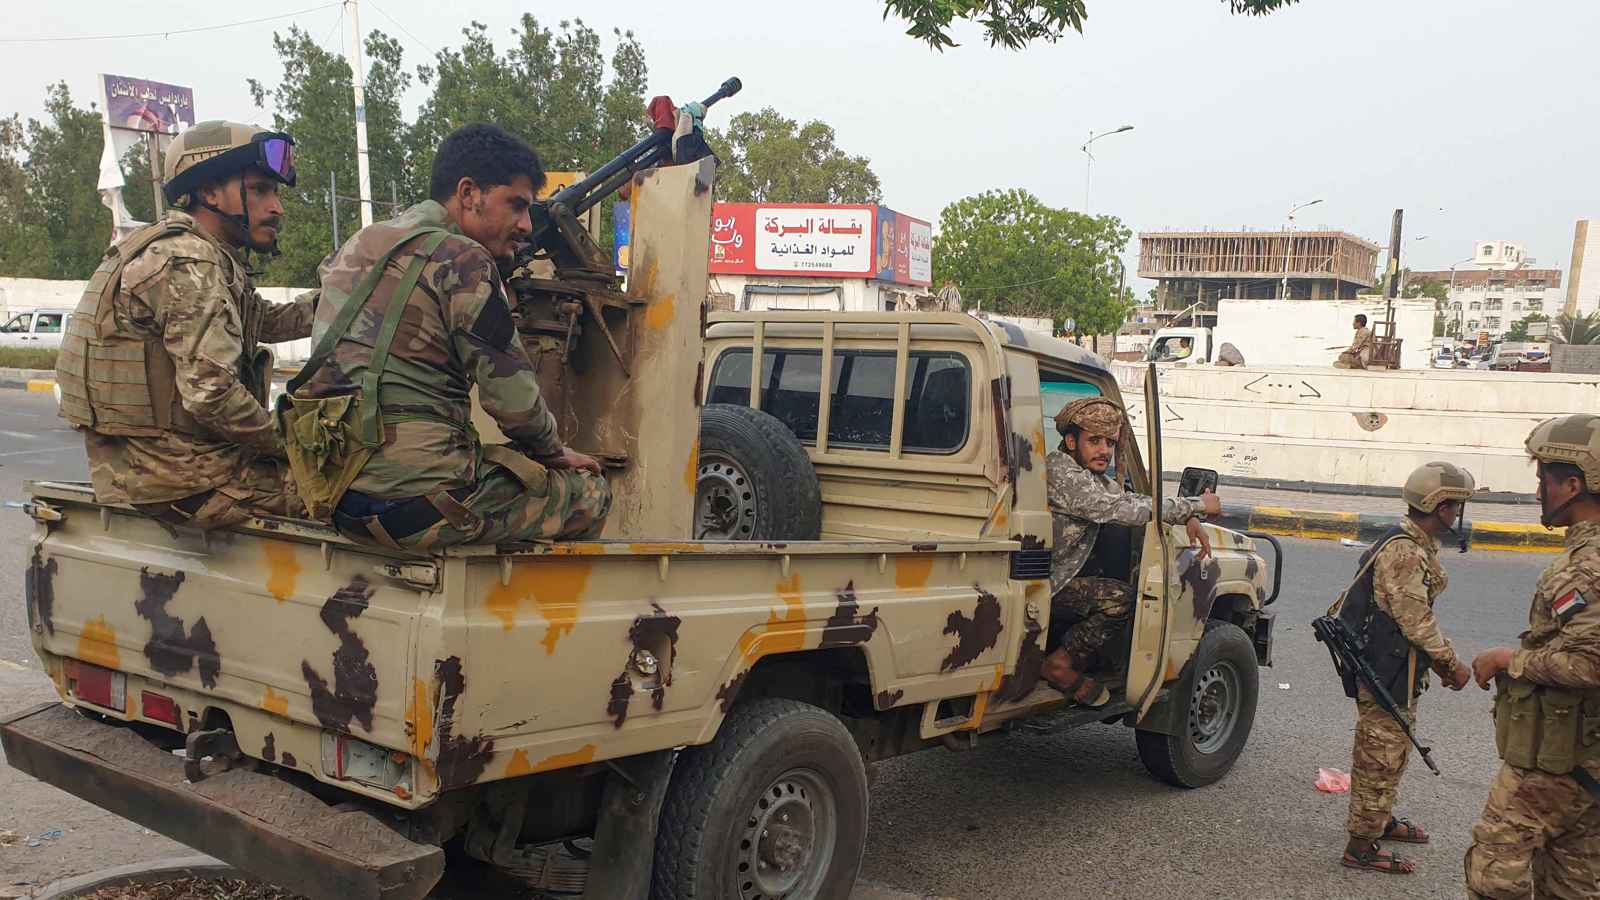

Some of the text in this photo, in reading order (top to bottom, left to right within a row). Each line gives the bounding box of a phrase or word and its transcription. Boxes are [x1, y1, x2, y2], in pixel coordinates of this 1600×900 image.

[764, 217, 814, 237] البركة
[818, 218, 863, 239] بقالة
[770, 242, 855, 258] للمواد الغذائية
